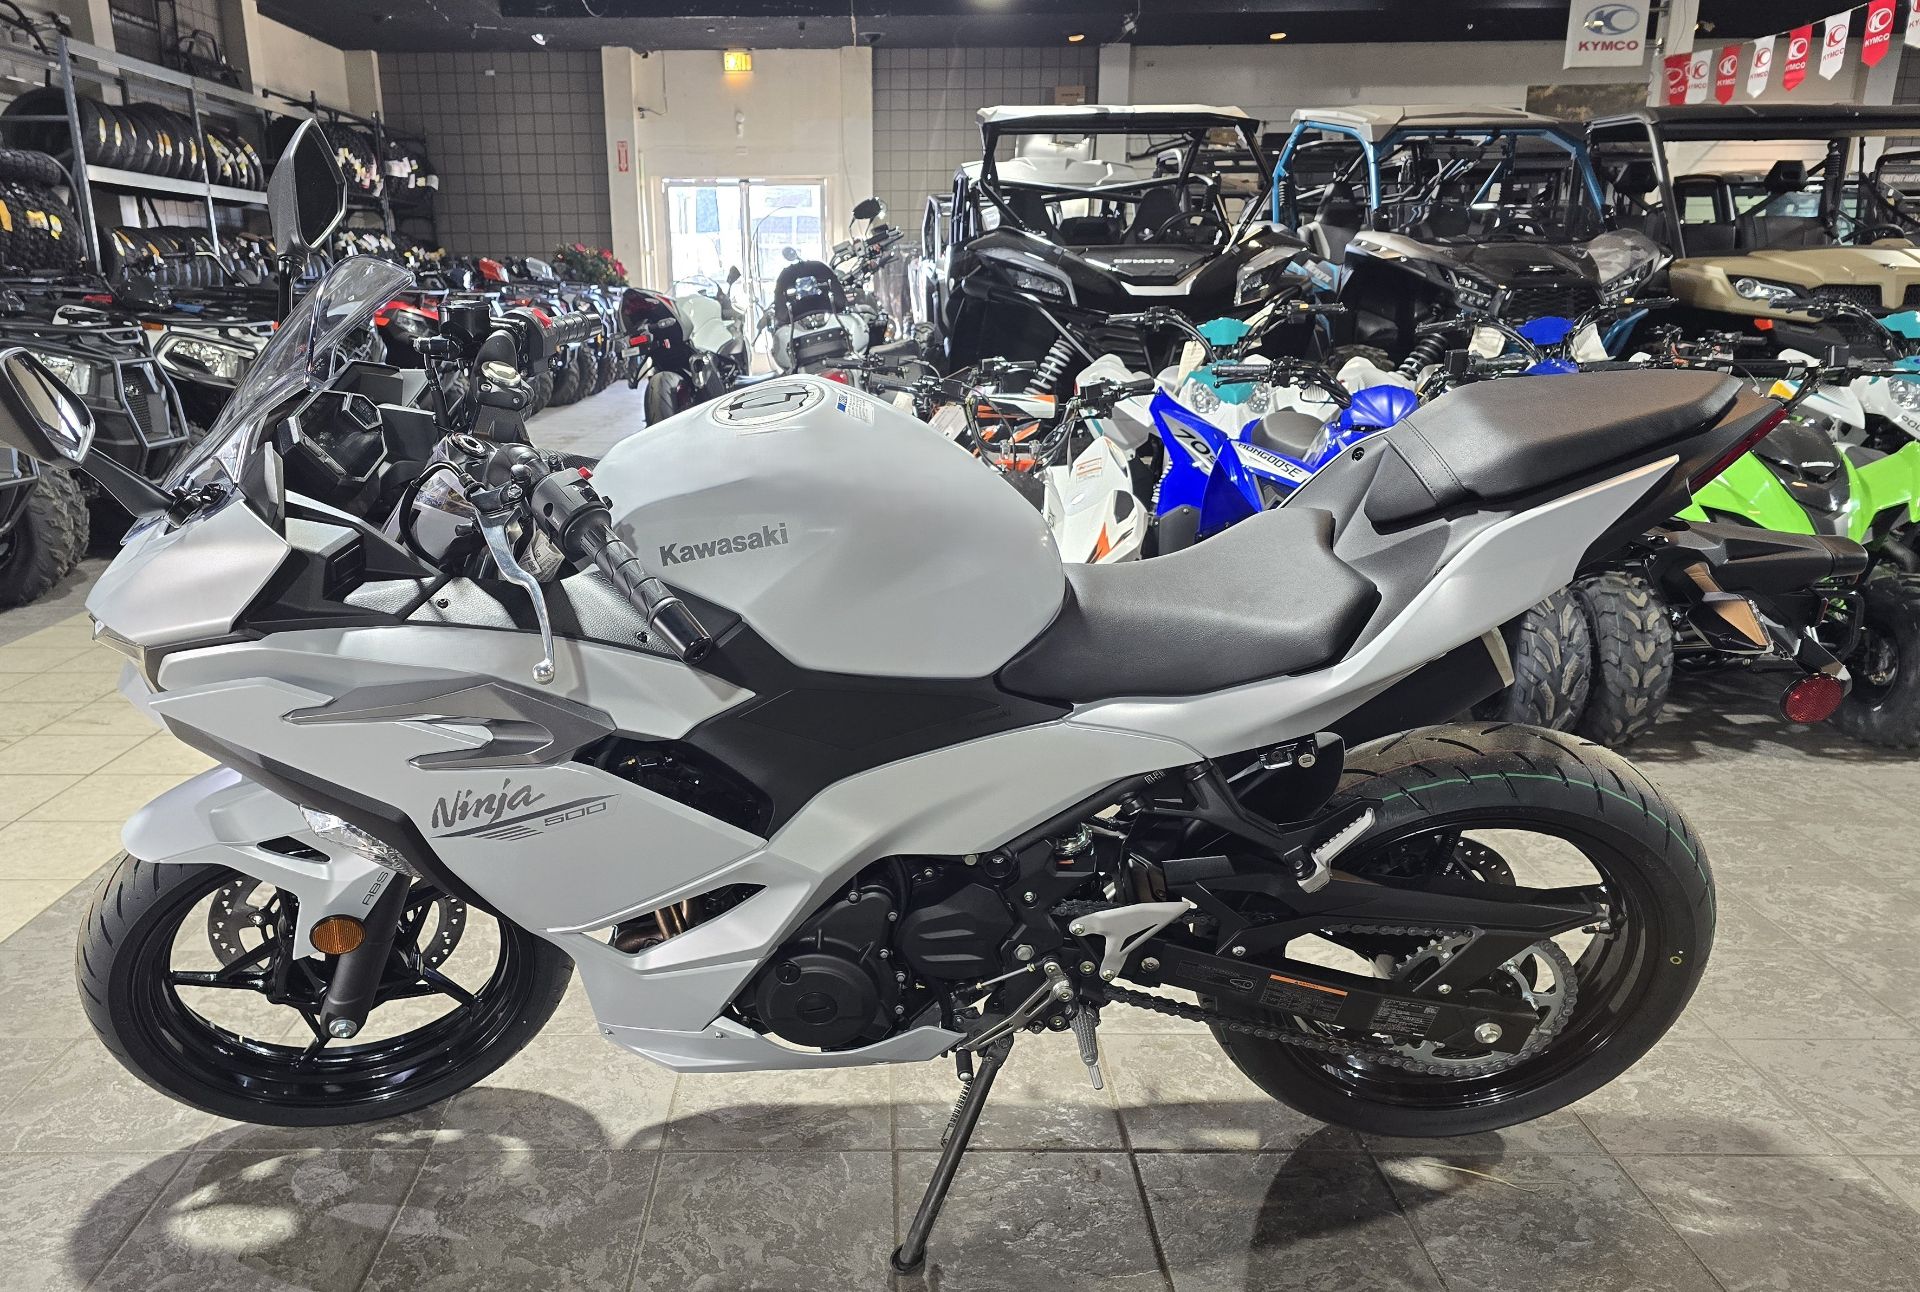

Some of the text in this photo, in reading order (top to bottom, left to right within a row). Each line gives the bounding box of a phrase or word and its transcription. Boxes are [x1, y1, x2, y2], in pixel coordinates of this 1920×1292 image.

[1578, 41, 1638, 51] KYMCO
[1865, 33, 1890, 47] KYMCO
[1823, 48, 1844, 61] KYMCO
[1717, 79, 1736, 87] KYMCO
[1750, 71, 1768, 79] KYMCO
[1238, 442, 1302, 478] MONGOOSE
[659, 522, 789, 567] Kawasaki
[431, 777, 546, 828] Ninja
[544, 801, 607, 827] 500
[362, 871, 388, 906] ABS
